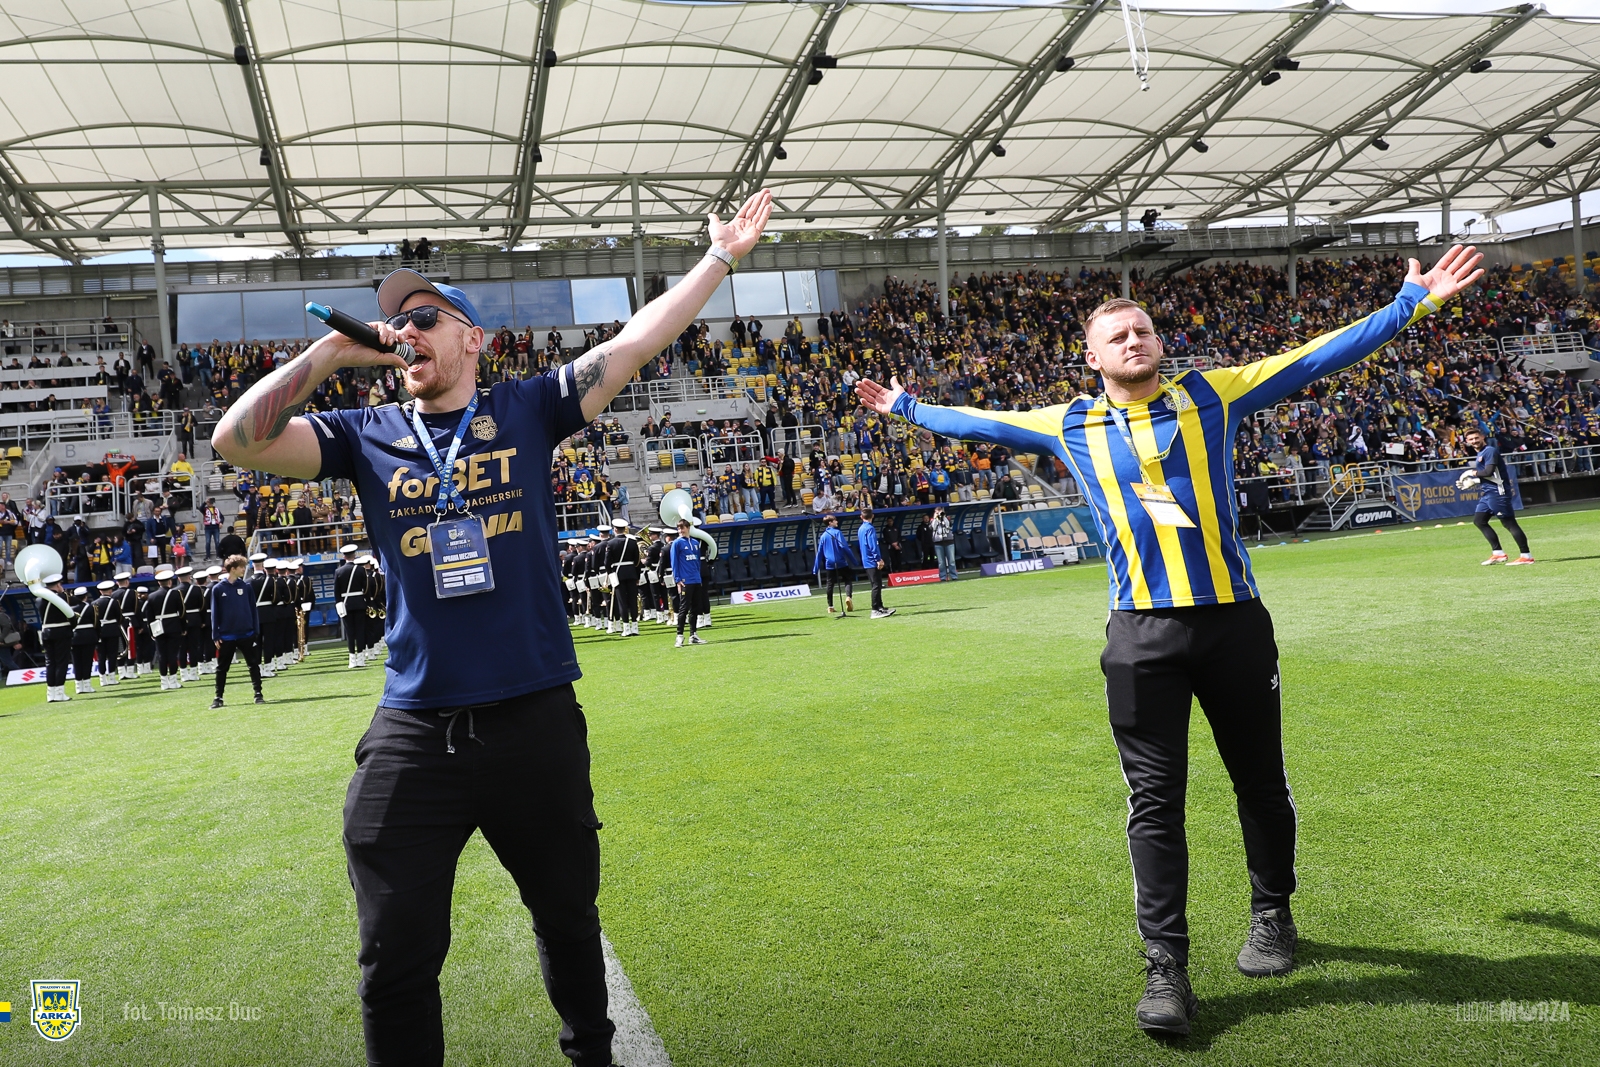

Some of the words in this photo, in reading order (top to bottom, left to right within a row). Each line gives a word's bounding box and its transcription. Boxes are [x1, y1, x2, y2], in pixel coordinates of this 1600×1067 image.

[730, 400, 738, 412] 4
[65, 444, 76, 458] B
[151, 438, 160, 453] 3
[388, 447, 517, 502] forBET
[1423, 485, 1455, 498] SOCIOS
[446, 488, 523, 512] UMACHERSKIE
[1355, 510, 1392, 524] GDYNIA
[400, 510, 523, 557] GNIA
[995, 559, 1044, 574] 4MOVE
[756, 588, 802, 600] SUZUKI
